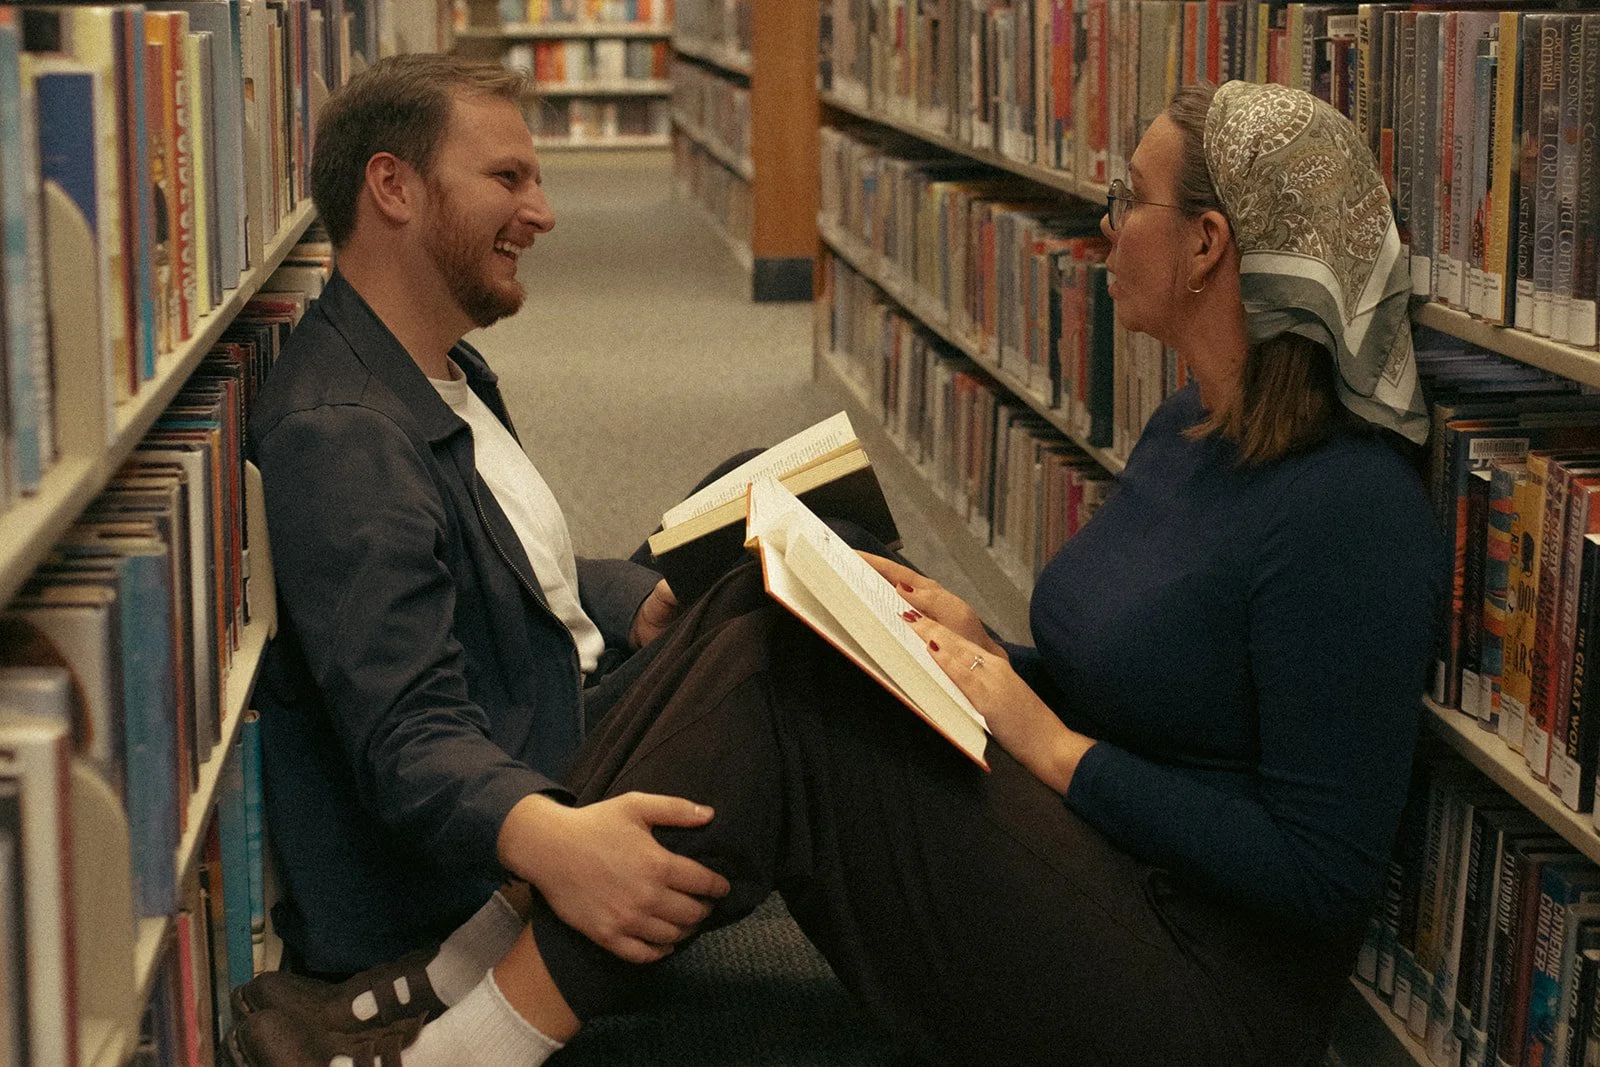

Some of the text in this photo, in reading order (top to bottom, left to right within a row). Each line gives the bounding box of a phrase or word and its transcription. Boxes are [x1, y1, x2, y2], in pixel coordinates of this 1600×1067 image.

[1358, 18, 1370, 133] THE MARAUDERS
[1541, 27, 1560, 92] Cornwell
[1566, 23, 1583, 117] SWORD SONG
[1584, 23, 1600, 114] BERNARD
[1418, 53, 1429, 180] ORCHARDIST
[1400, 166, 1412, 223] KIND
[1520, 185, 1531, 218] LAST
[1538, 133, 1561, 201] LORDS
[1558, 155, 1579, 224] Bernard
[1579, 122, 1597, 226] CORNWELL
[1534, 219, 1556, 293] NORTH
[1509, 511, 1521, 568] GORDO
[1548, 518, 1561, 577] COSBY
[1567, 496, 1582, 566] CARMEN
[1560, 589, 1576, 650] GRACE
[1577, 627, 1586, 649] THE
[1571, 652, 1586, 712] GREAT
[1567, 715, 1581, 758] WOR
[1467, 821, 1483, 904] RECKONING
[1496, 852, 1516, 936] FLASHPOINT
[1385, 862, 1403, 936] DEADL
[1533, 892, 1554, 974] COULTER
[1544, 901, 1566, 983] CATHERINE
